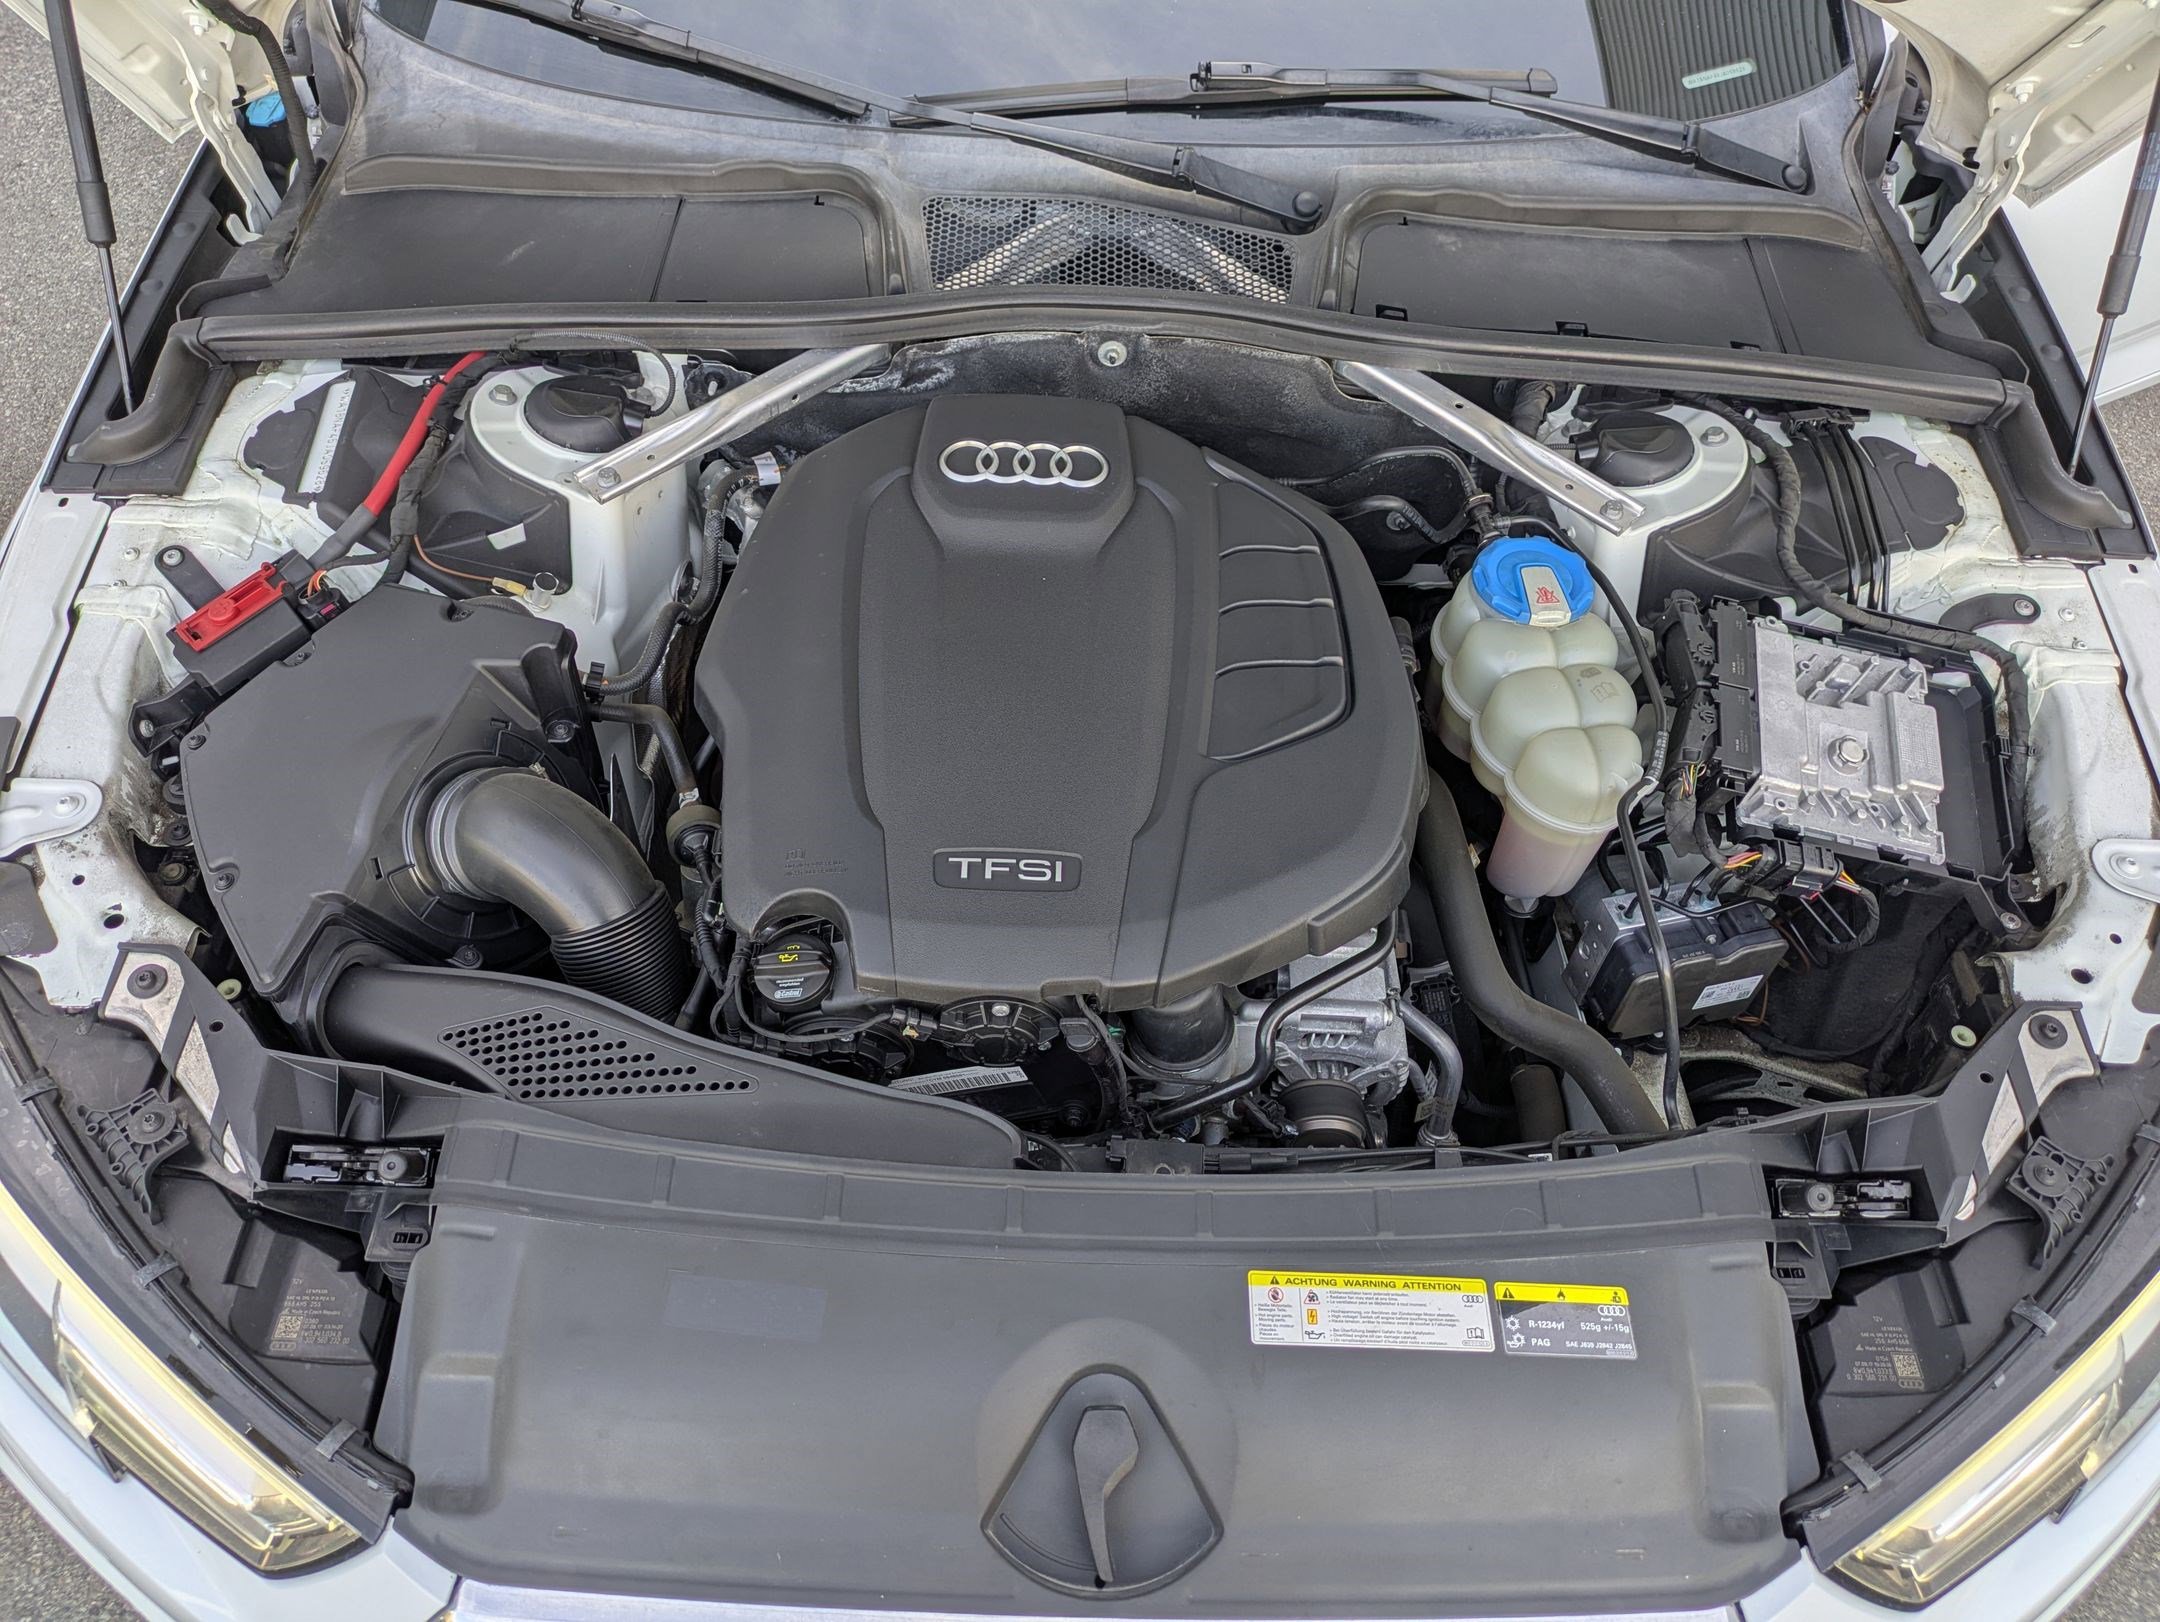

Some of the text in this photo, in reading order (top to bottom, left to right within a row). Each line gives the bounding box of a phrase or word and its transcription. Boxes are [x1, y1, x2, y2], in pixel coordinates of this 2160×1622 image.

[948, 857, 1062, 882] TFSI
[1285, 1278, 1462, 1291] ACHTUNG WARNING ATTENTION
[1581, 1322, 1600, 1332] 525g
[1532, 1338, 1551, 1346] PAG
